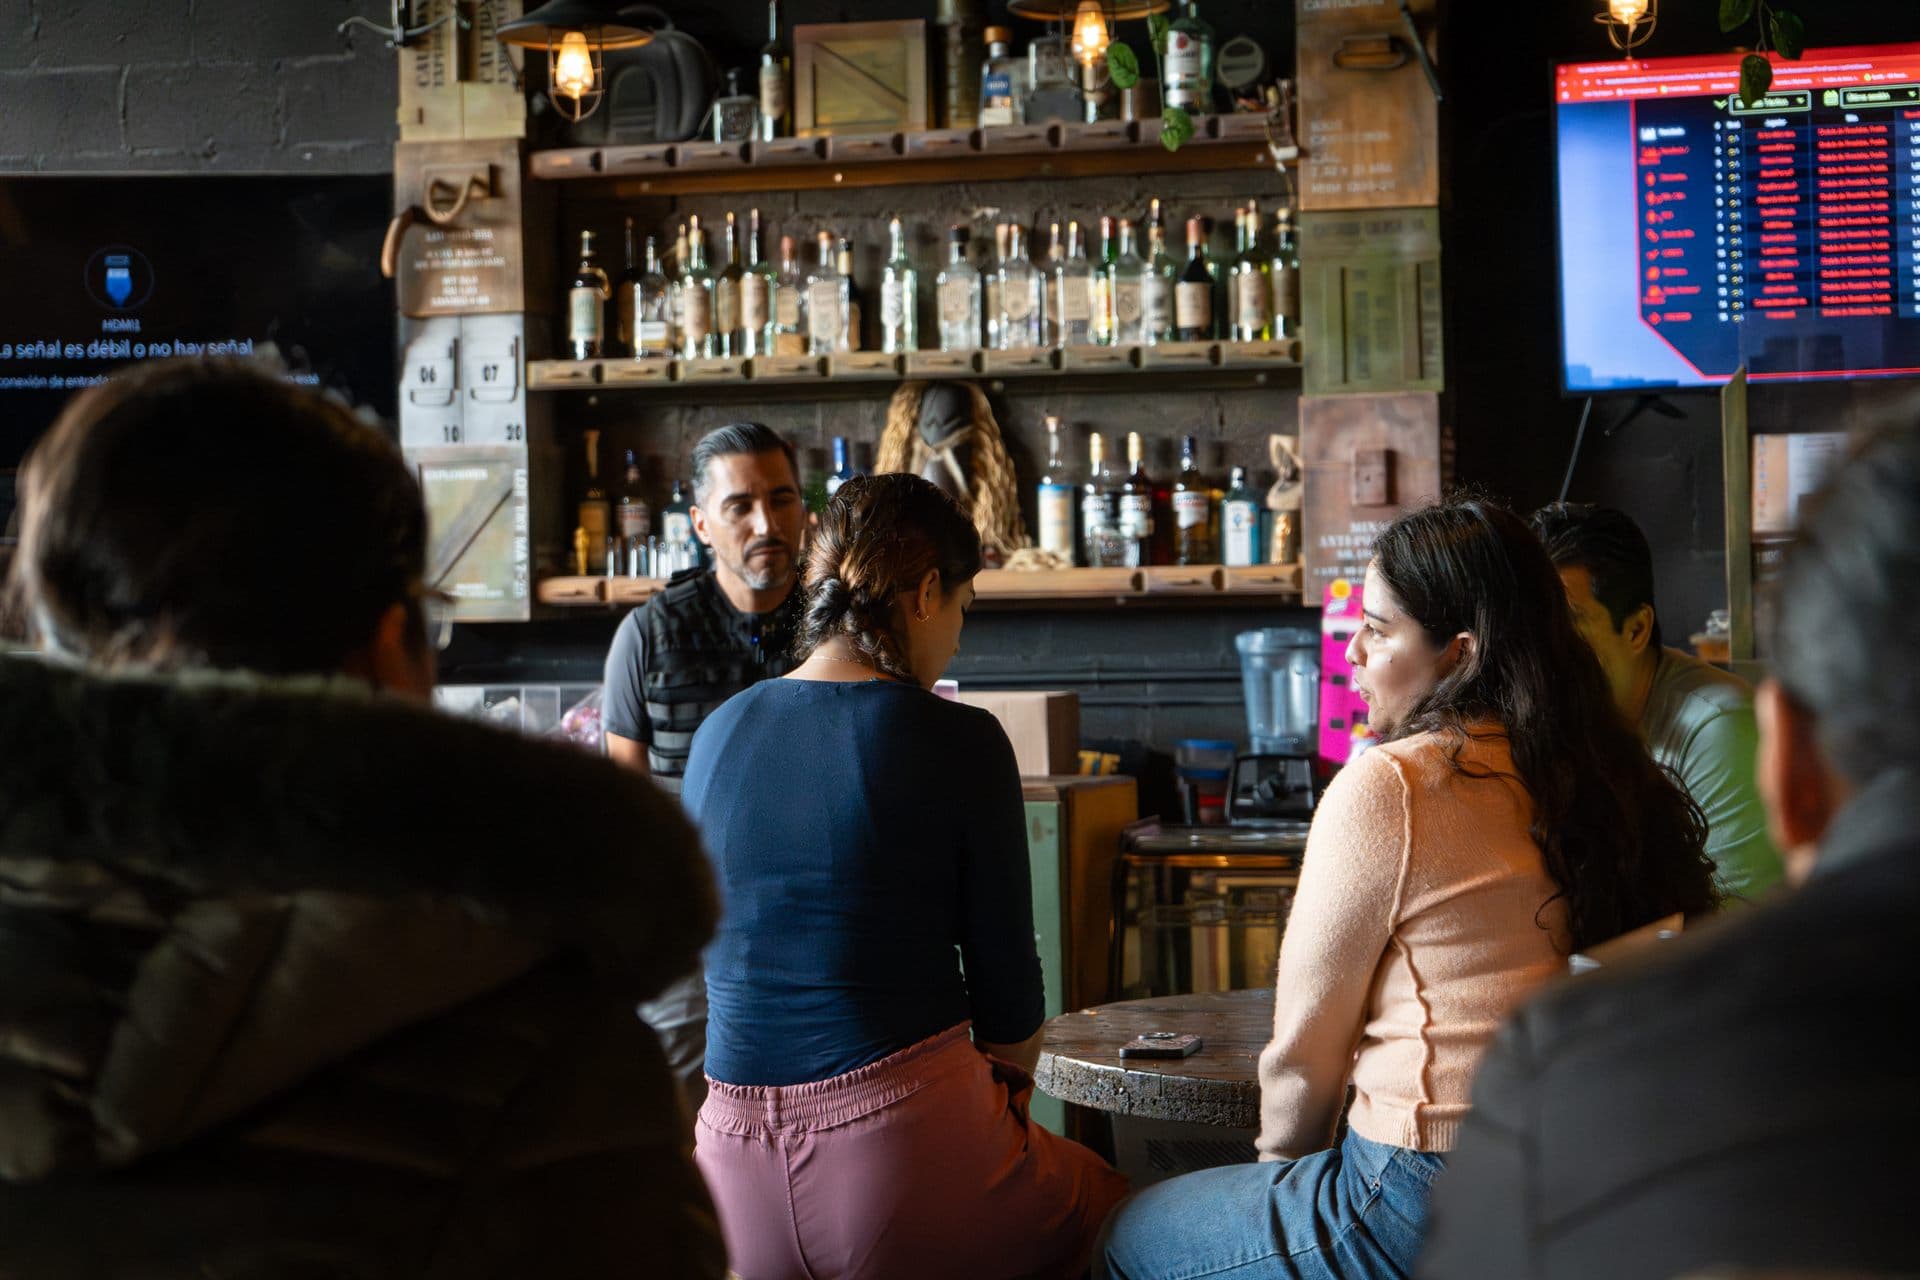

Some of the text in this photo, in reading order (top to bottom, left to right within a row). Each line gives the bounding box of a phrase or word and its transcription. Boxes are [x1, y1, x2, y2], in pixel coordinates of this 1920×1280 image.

[15, 339, 62, 359] señal
[64, 343, 85, 359] es
[87, 339, 131, 359] débil
[133, 343, 146, 359] o
[148, 343, 173, 358] no
[174, 338, 205, 358] hay
[207, 338, 254, 357] señal
[419, 365, 436, 383] 06
[482, 364, 498, 382] 07
[443, 425, 460, 442] 10
